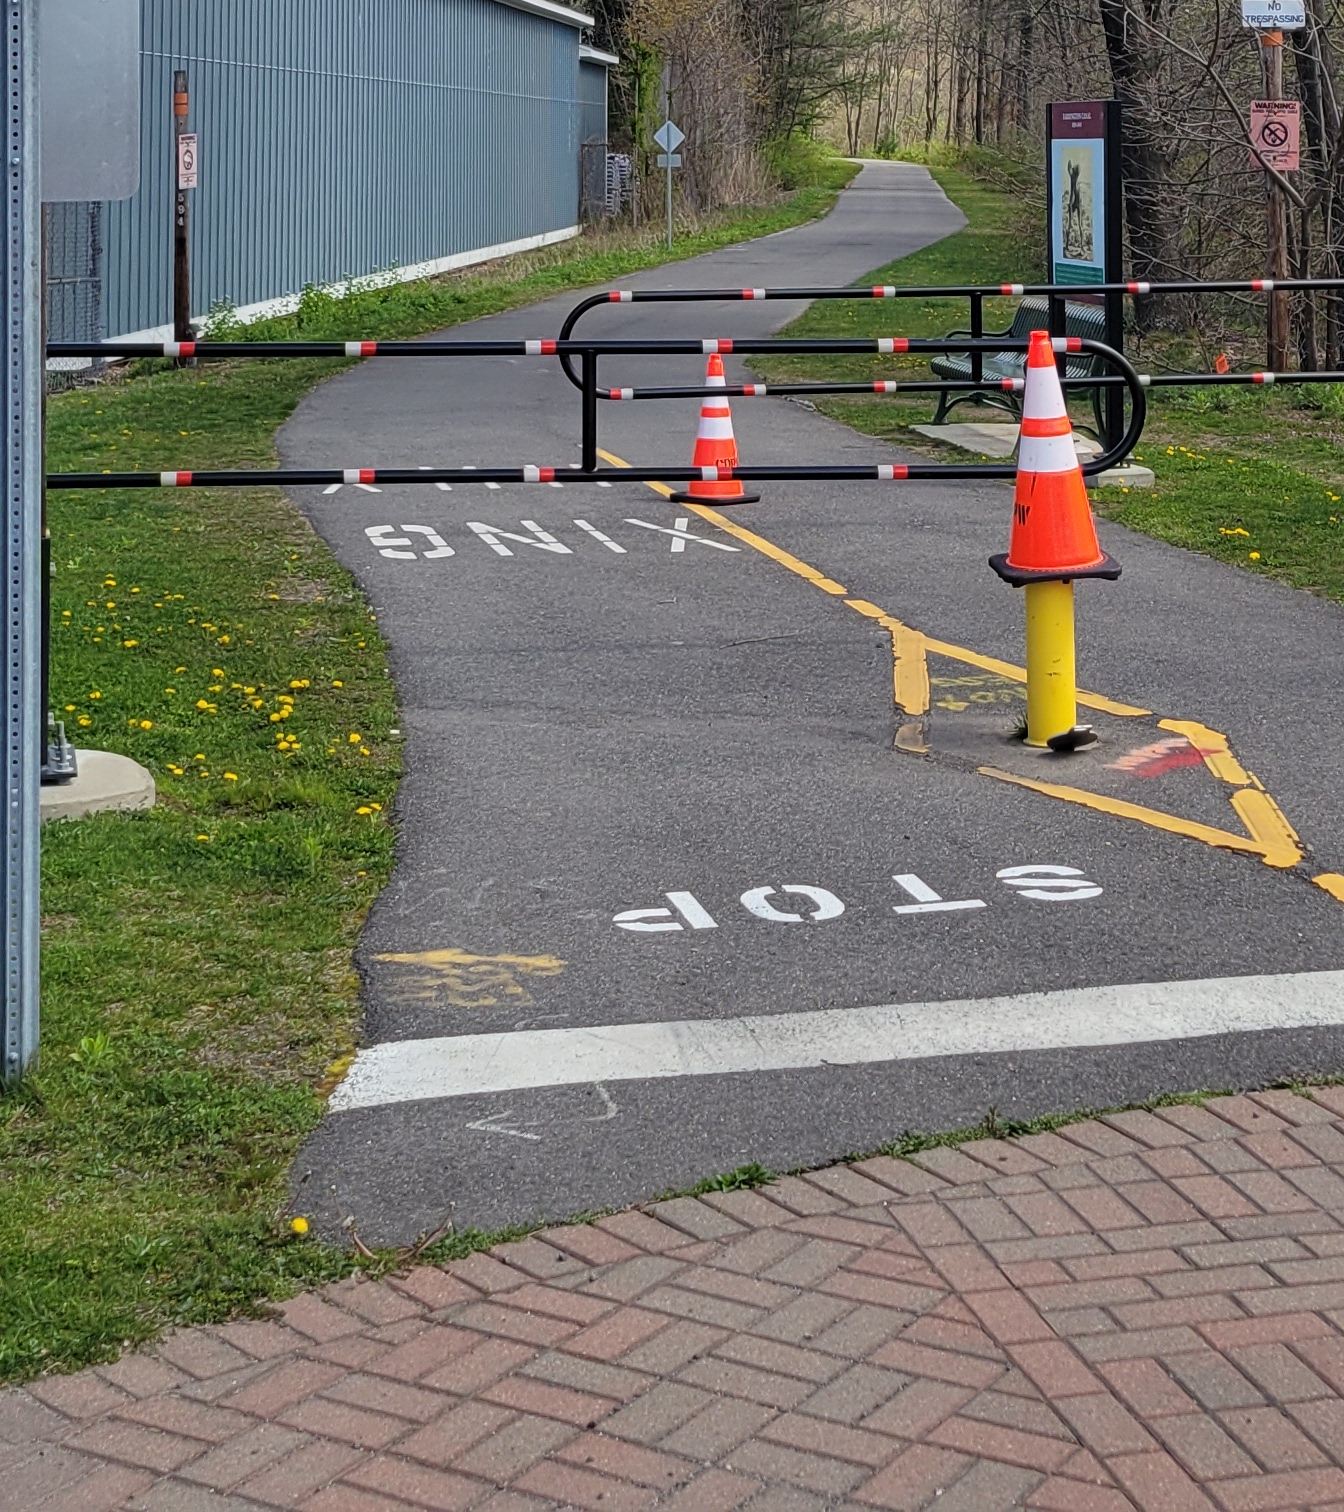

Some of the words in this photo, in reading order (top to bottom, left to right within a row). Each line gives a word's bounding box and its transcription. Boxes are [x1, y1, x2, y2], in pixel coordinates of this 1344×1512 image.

[1245, 14, 1304, 23] TRESPASSING
[1267, 2, 1282, 11] NO
[364, 516, 741, 560] XING
[612, 862, 1104, 933] STOP
